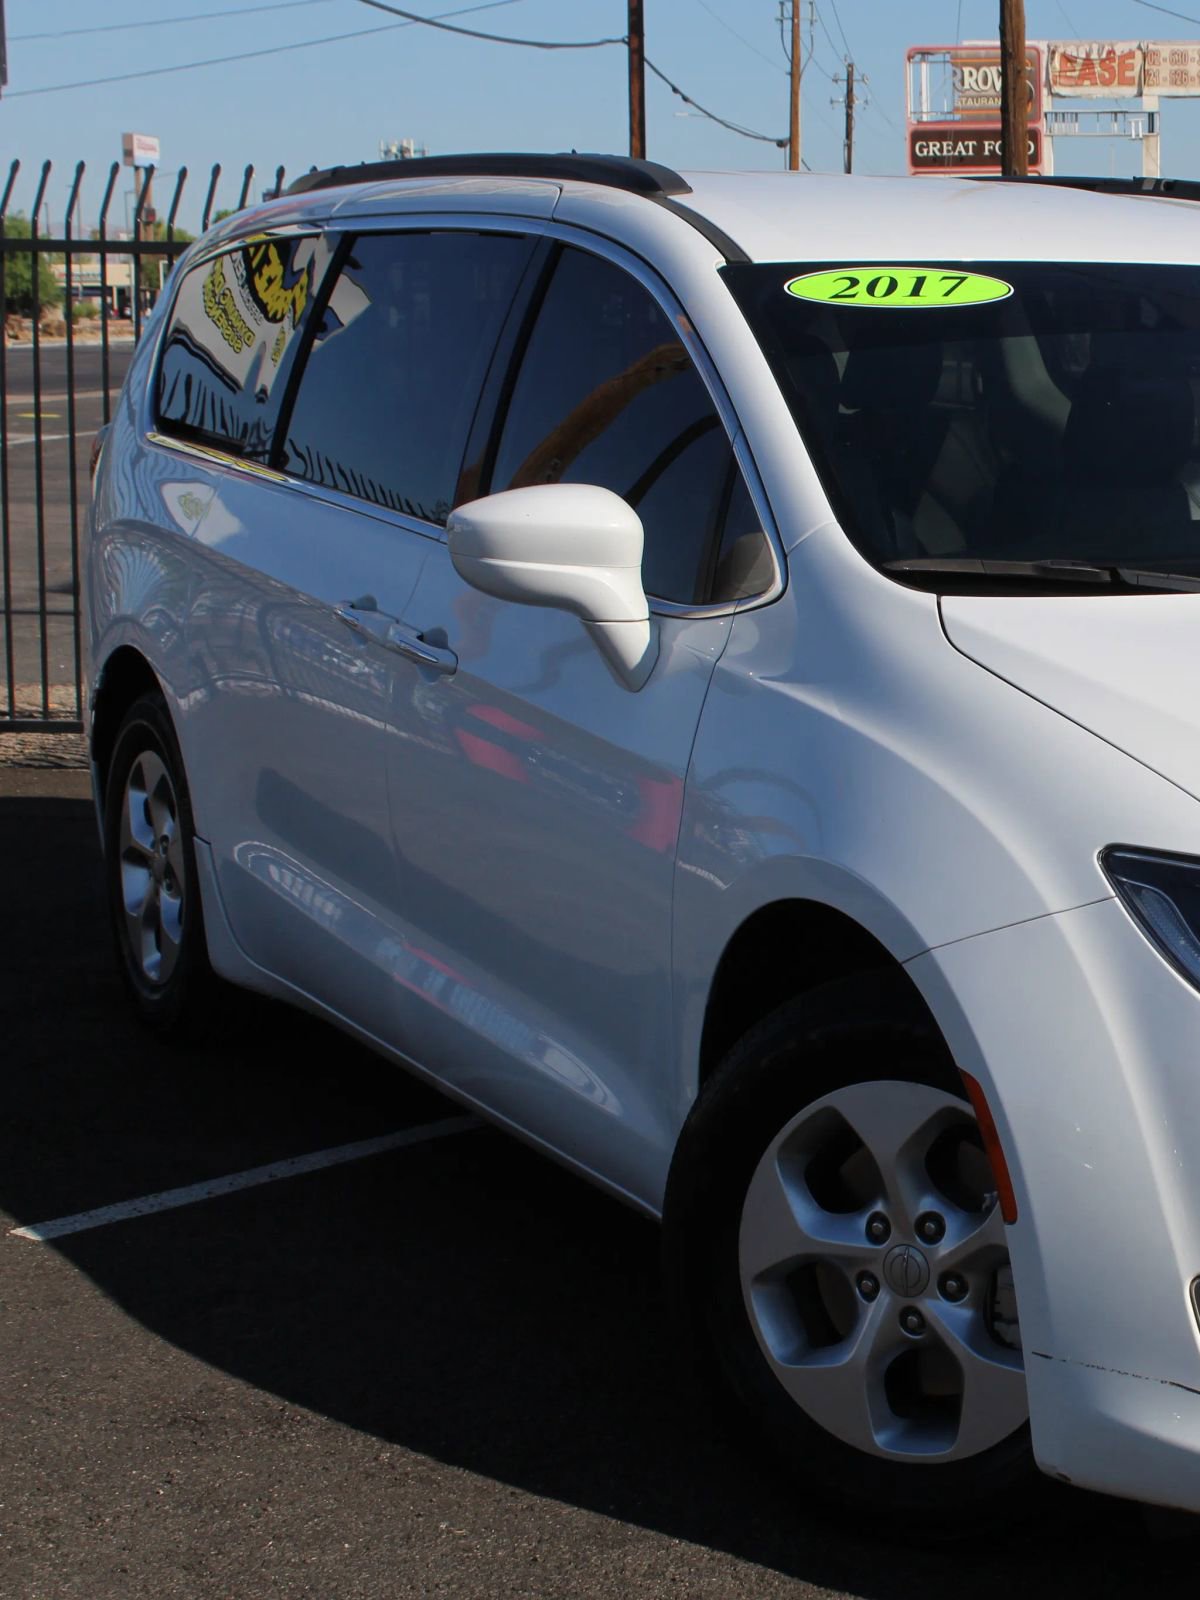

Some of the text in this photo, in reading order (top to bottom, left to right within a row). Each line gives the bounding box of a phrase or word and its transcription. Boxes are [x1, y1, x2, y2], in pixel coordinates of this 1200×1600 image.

[1052, 49, 1136, 87] EASE
[915, 141, 977, 157] GREAT
[828, 275, 968, 299] 2017
